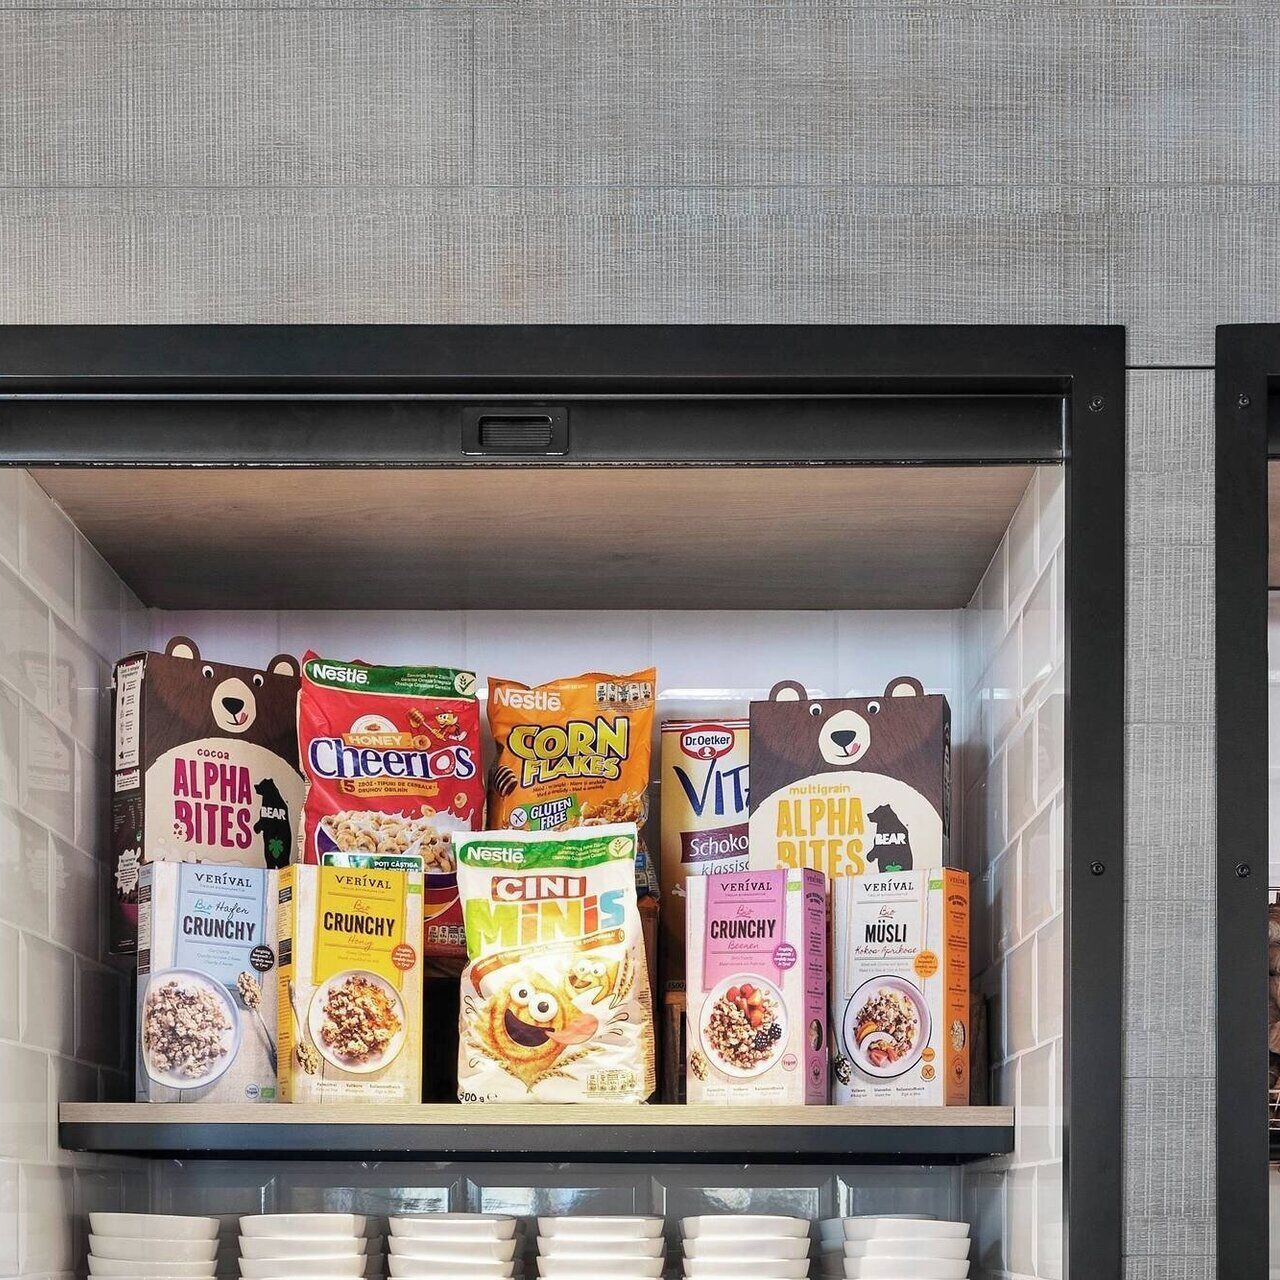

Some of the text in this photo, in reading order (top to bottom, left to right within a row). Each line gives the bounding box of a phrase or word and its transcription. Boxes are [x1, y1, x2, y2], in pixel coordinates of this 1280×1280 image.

[349, 735, 403, 746] HONEY
[509, 717, 628, 760] CORN
[197, 748, 229, 760] cocoa
[310, 740, 474, 778] Cheerios
[173, 758, 252, 805] ALPHA
[523, 757, 620, 787] FLAKES
[344, 780, 355, 792] 5
[672, 759, 749, 817] VIT
[790, 783, 850, 796] multigrain
[260, 807, 286, 820] BEAR
[531, 797, 572, 819] GLUTEN
[776, 798, 864, 838] ALPHA
[174, 800, 252, 849] BITES
[541, 811, 567, 831] FREE
[690, 833, 749, 857] Schoko
[875, 833, 906, 845] BEAR
[701, 860, 749, 876] klassisc
[777, 839, 865, 879] BITES
[496, 876, 579, 899] CINI
[183, 916, 256, 941] CRUNCHY
[324, 912, 395, 937] CRUNCHY
[711, 920, 776, 939] CRUNCHY
[865, 920, 907, 943] MÜSLI
